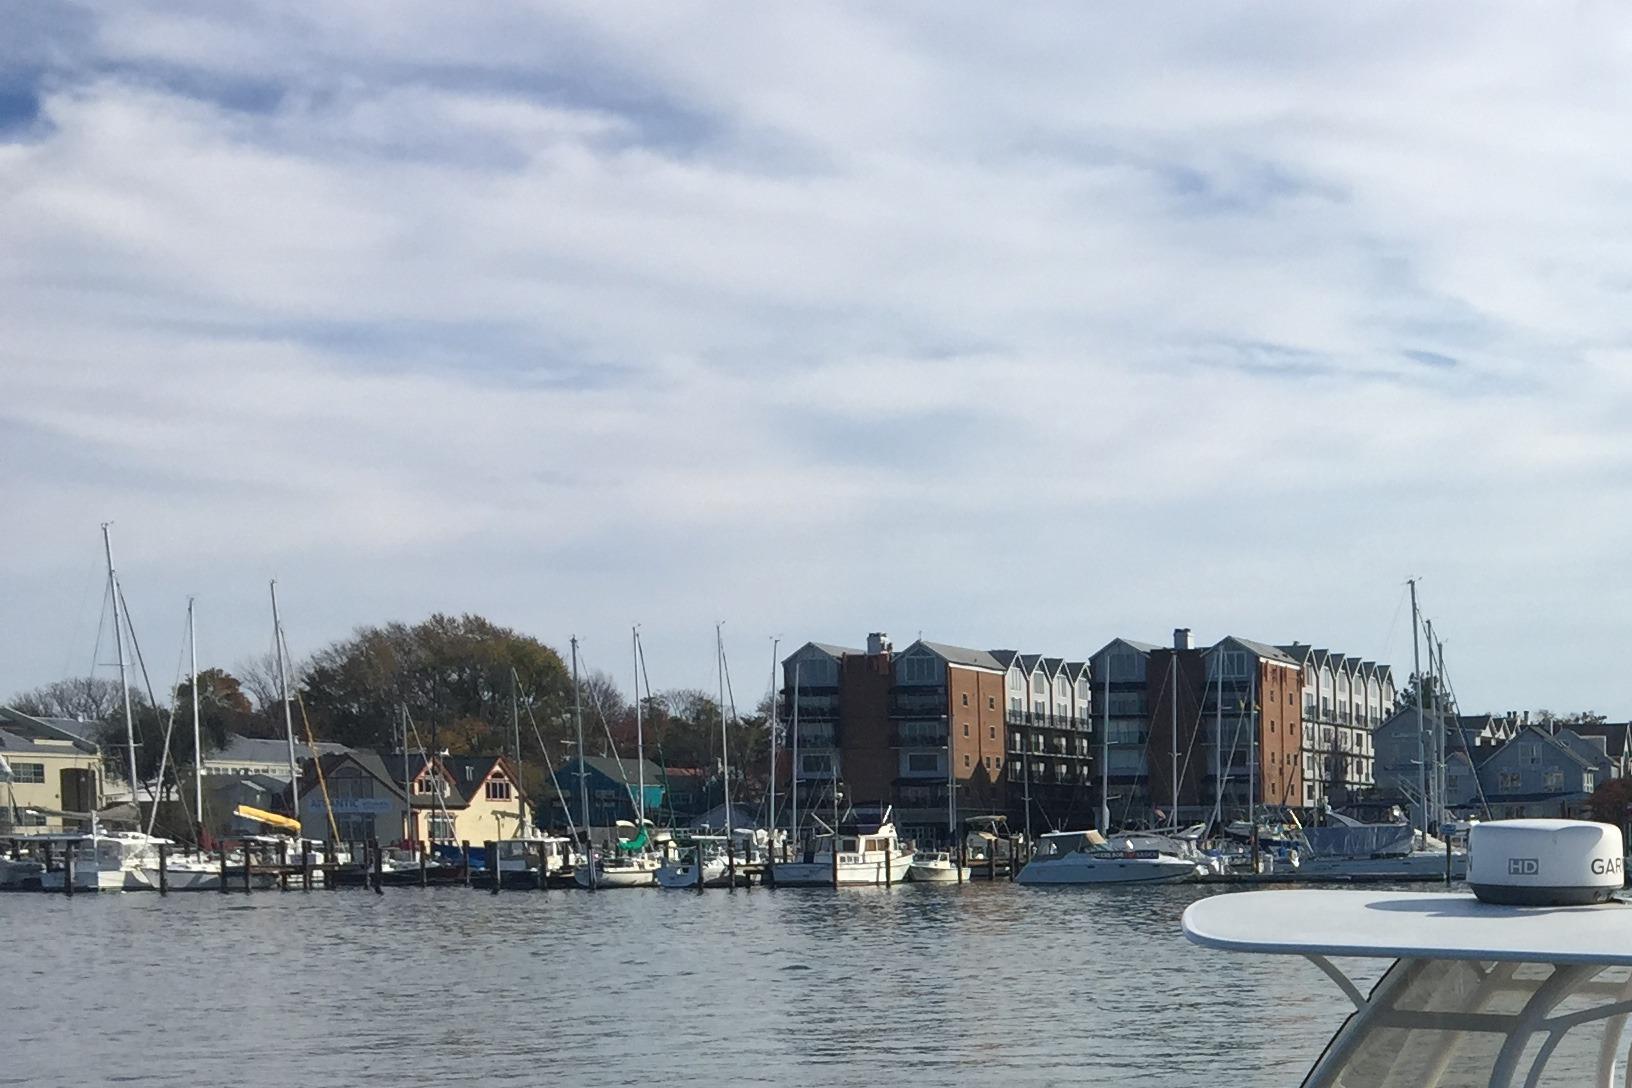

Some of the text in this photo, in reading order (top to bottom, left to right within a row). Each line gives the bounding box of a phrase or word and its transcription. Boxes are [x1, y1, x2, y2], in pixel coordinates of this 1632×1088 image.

[311, 800, 358, 809] ATNTIC
[1509, 859, 1537, 874] HD
[1591, 858, 1623, 875] GAR
